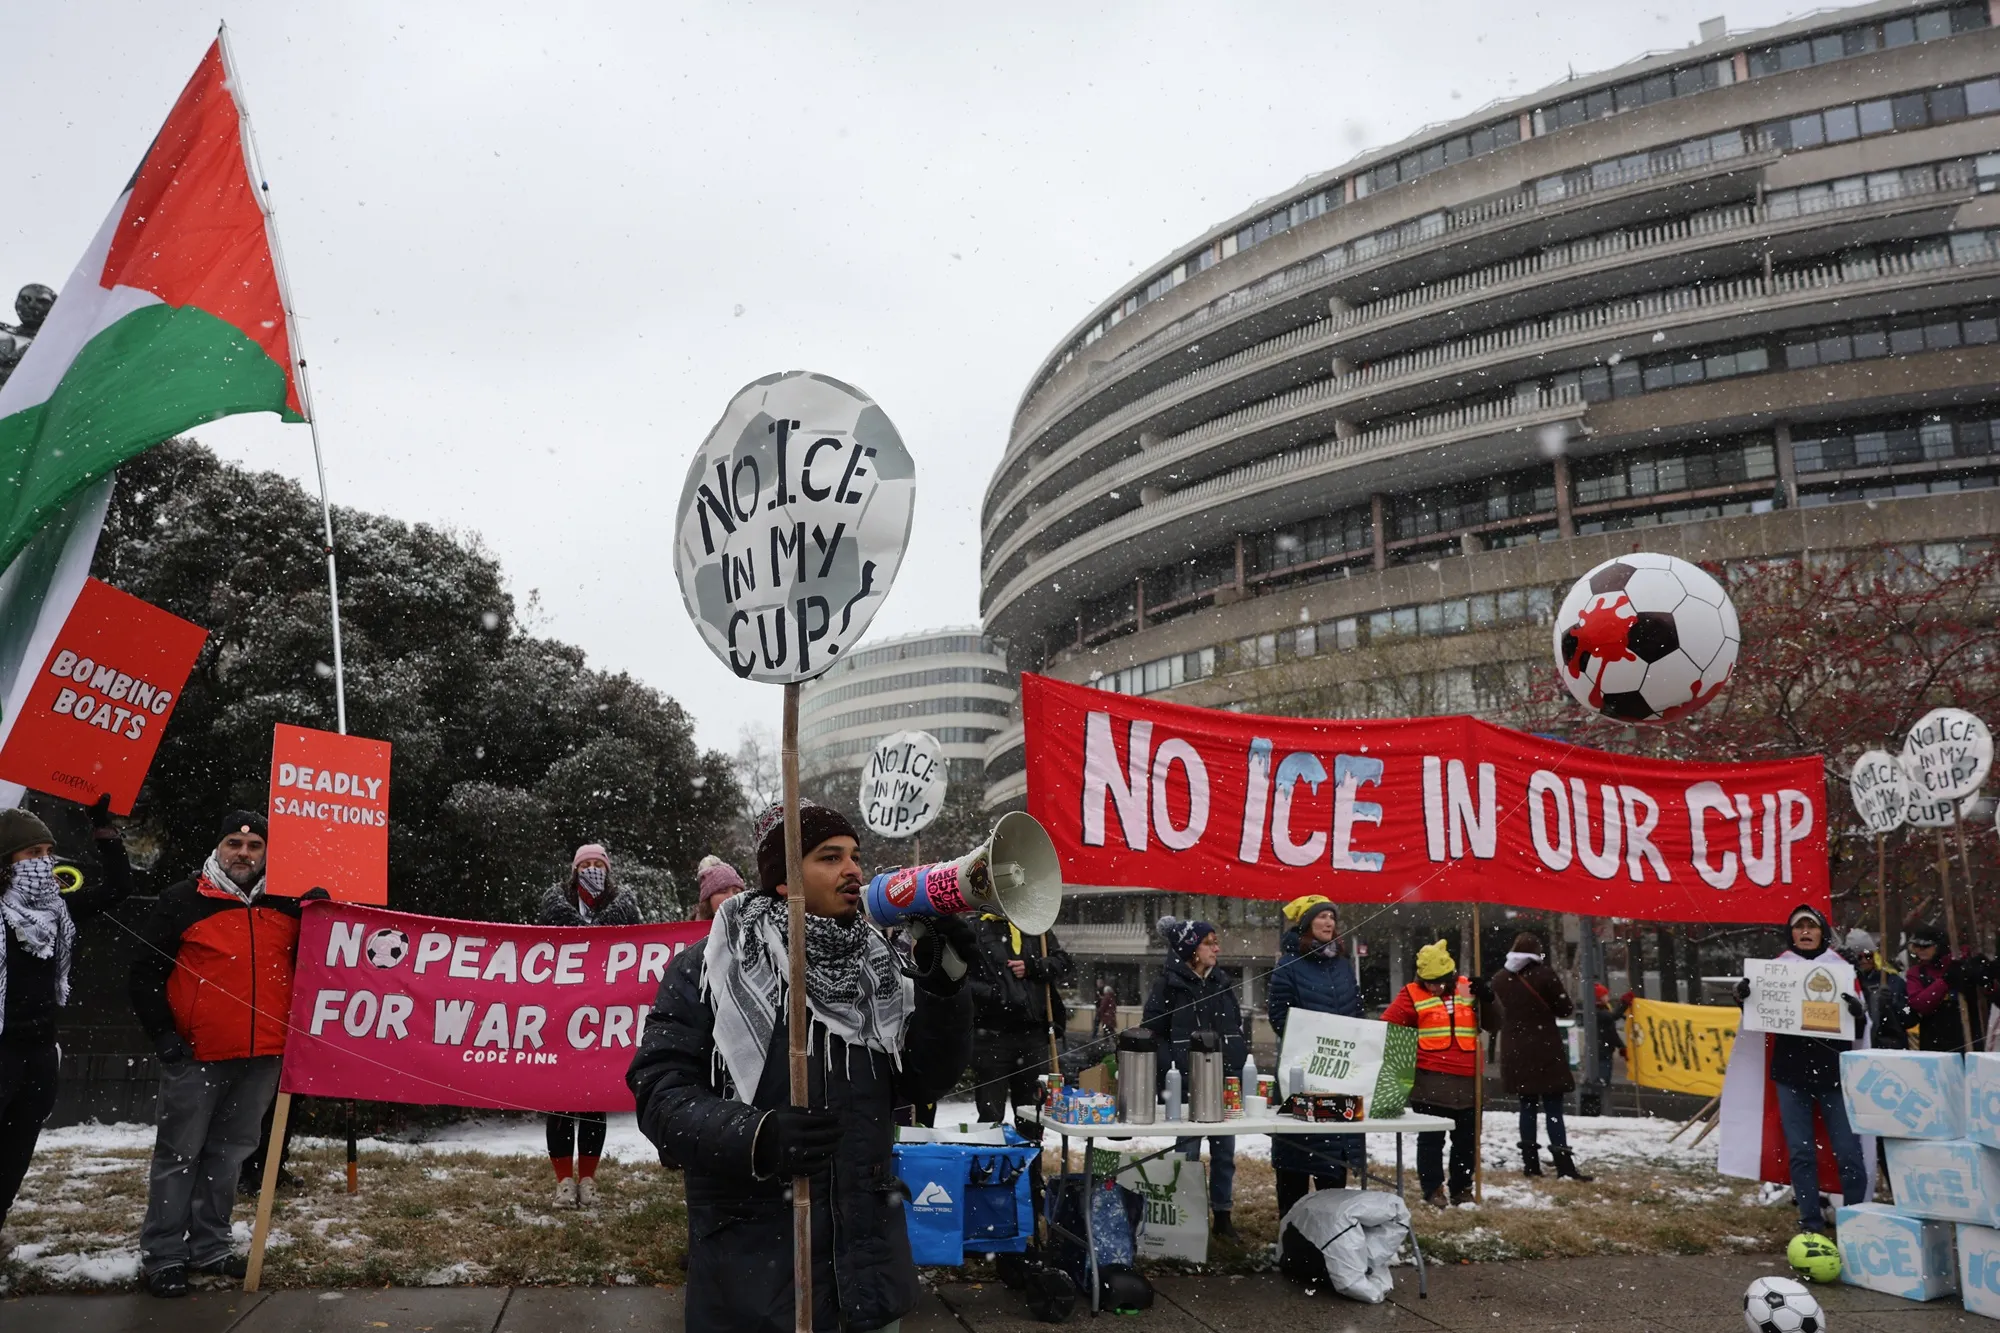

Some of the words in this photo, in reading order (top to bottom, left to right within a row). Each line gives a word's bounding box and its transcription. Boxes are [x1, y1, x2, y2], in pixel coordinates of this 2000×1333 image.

[697, 454, 760, 556] NO
[767, 418, 877, 511] ICE
[721, 547, 756, 604] IN
[770, 521, 846, 587] MY
[728, 560, 877, 678] CUP!
[49, 648, 173, 715] BOMBING
[51, 687, 147, 740] BOATS
[1909, 727, 1934, 755] NO
[1937, 717, 1976, 742] ICE
[872, 747, 899, 778] NO
[897, 743, 938, 783] ICE
[1920, 753, 1936, 769] IN
[1940, 746, 1967, 765] MY
[51, 770, 99, 795] CODEPINK
[278, 763, 383, 800] DEADLY
[1853, 773, 1871, 799] NO
[1869, 762, 1897, 786] ICE
[1924, 757, 1979, 791] CUP!
[874, 779, 888, 798] IN
[892, 779, 922, 803] MY
[1081, 711, 1210, 852] NO
[1238, 736, 1386, 872] ICE
[1422, 755, 1497, 863] IN
[1527, 769, 1672, 883] OUR
[1684, 780, 1814, 890] CUP
[1876, 788, 1895, 806] MY
[274, 796, 387, 827] SANCTIONS
[868, 801, 930, 831] CUP!
[927, 876, 957, 894] OUT
[928, 867, 958, 884] MAKE
[930, 888, 960, 903] NOT
[413, 931, 591, 985] PEACE
[1764, 963, 1789, 976] FIFA
[1756, 976, 1787, 989] Piece
[1761, 989, 1792, 1003] PRIZE
[309, 988, 414, 1040] FOR
[433, 998, 547, 1051] WAR
[1756, 1003, 1780, 1016] Goes
[1785, 1004, 1796, 1017] to
[1760, 1016, 1795, 1029] TRUMP
[462, 1049, 508, 1064] CODE
[515, 1052, 558, 1065] PINK
[1316, 1036, 1341, 1047] TIME
[1343, 1040, 1356, 1050] TO
[1317, 1046, 1351, 1059] BREAK
[1308, 1055, 1351, 1080] BREAD
[1856, 1063, 1932, 1130] ICE
[1903, 1168, 1970, 1209] ICE
[1844, 1236, 1918, 1278] ICE
